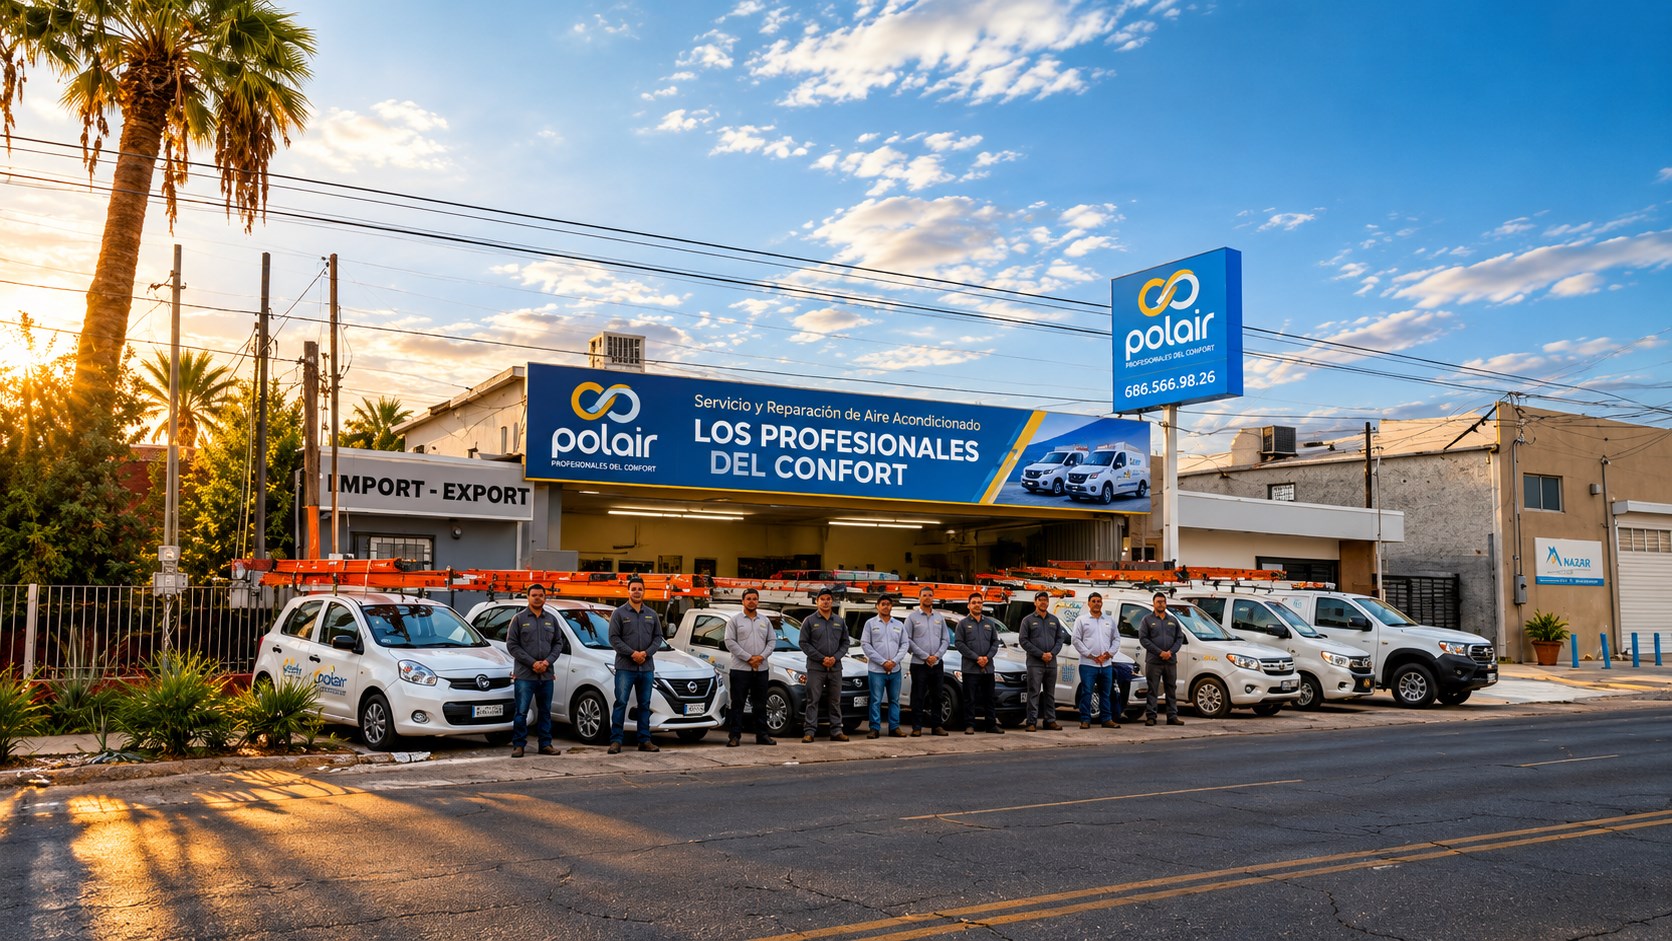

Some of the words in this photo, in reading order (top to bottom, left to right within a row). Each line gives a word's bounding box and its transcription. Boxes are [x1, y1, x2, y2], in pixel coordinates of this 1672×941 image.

[1125, 308, 1215, 361] polair
[1125, 370, 1216, 398] 686.566.98.26
[694, 394, 752, 412] Servicio
[755, 402, 764, 416] y
[767, 400, 841, 419] Reparación
[844, 407, 861, 421] de
[864, 409, 889, 423] Aire
[892, 412, 981, 431] Acondicionado
[551, 423, 658, 459] polair
[694, 418, 752, 446] LOS
[761, 423, 980, 463] PROFESIONALES
[609, 463, 622, 471] DEL
[624, 464, 657, 473] CONFORT
[710, 450, 766, 477] DEL
[774, 455, 908, 486] CONFORT
[328, 473, 425, 498] IMPORT
[443, 482, 530, 505] EXPORT
